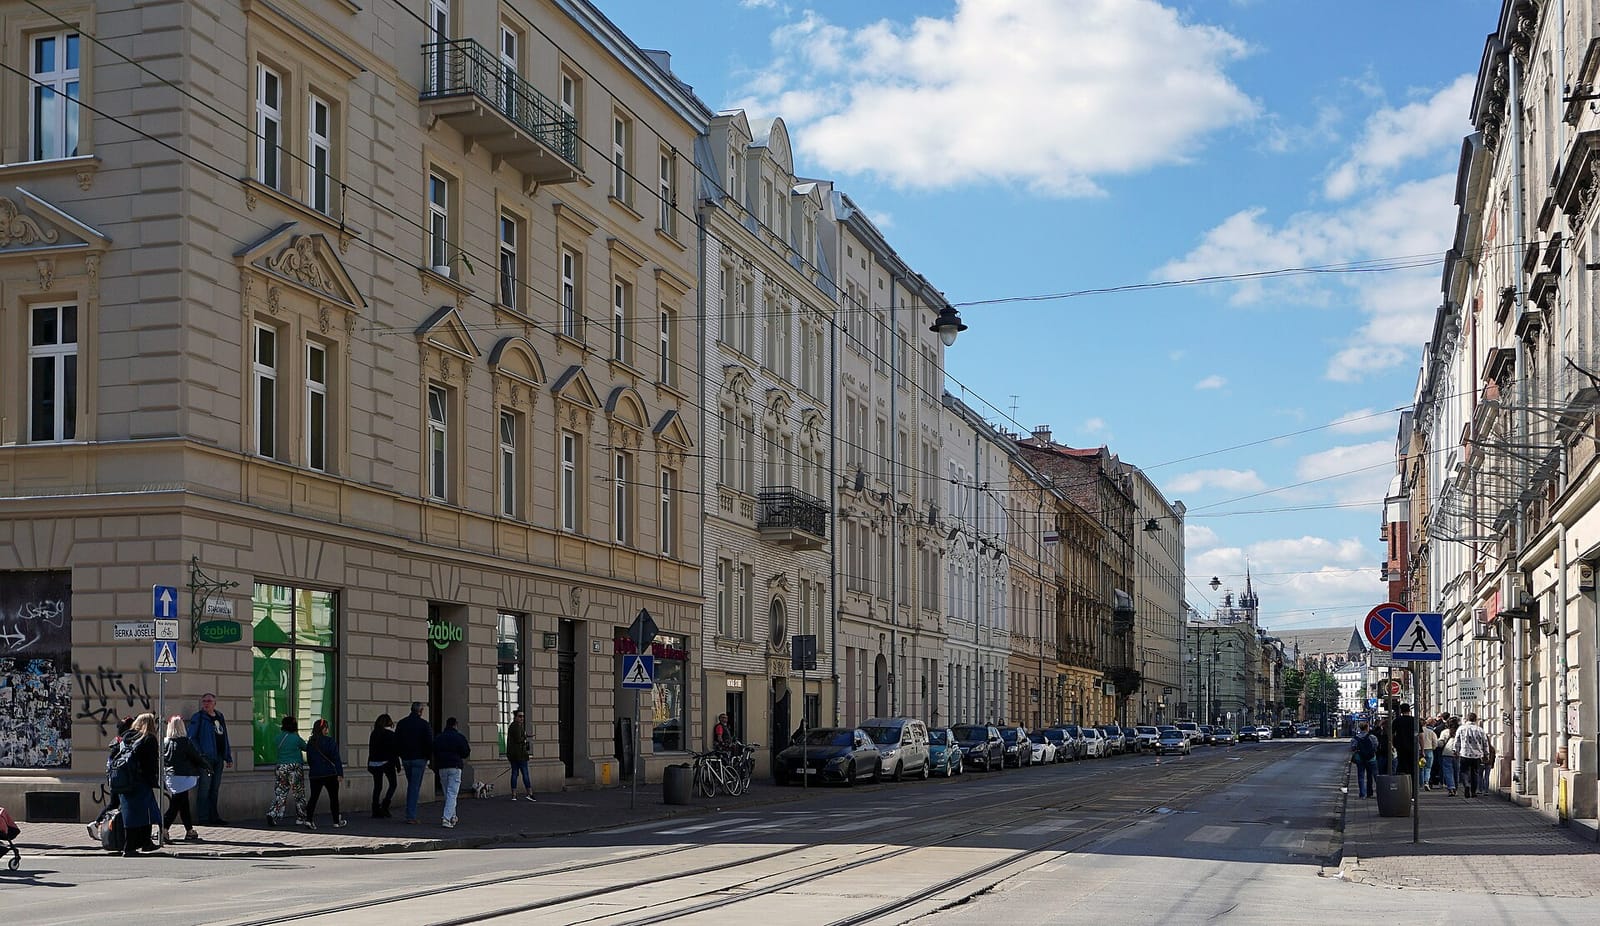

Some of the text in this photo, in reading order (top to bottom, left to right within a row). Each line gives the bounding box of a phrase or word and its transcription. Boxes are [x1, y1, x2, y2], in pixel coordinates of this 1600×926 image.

[134, 628, 155, 637] JOSELE
[203, 625, 237, 636] żabka
[429, 619, 463, 641] żabka
